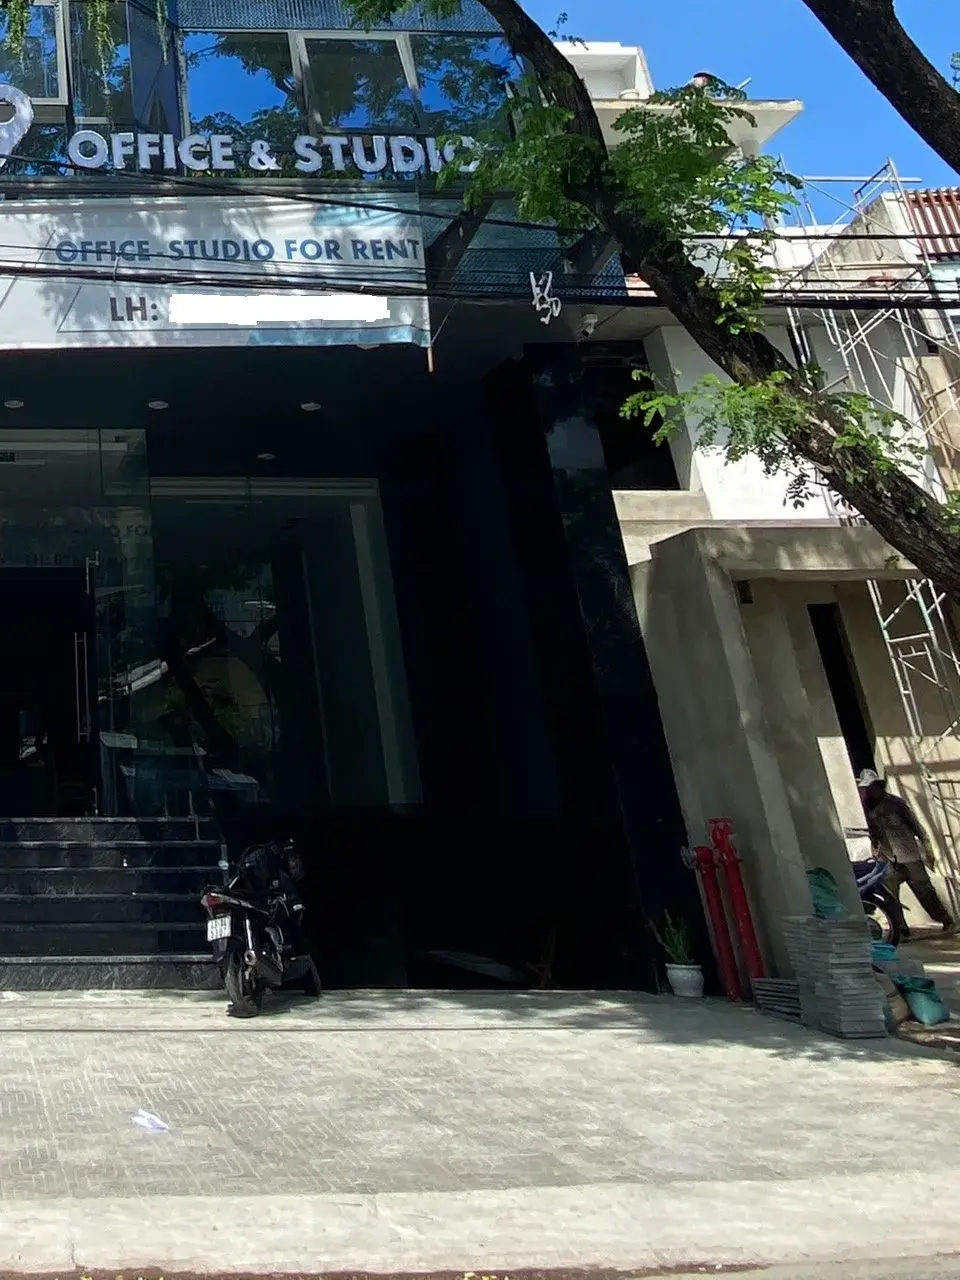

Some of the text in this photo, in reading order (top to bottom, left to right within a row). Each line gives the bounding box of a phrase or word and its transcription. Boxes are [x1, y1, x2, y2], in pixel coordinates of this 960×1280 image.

[68, 131, 231, 171] OFFICE
[249, 139, 281, 171] &
[286, 238, 343, 261] FOR
[352, 238, 421, 261] RENT
[109, 296, 159, 322] LH:
